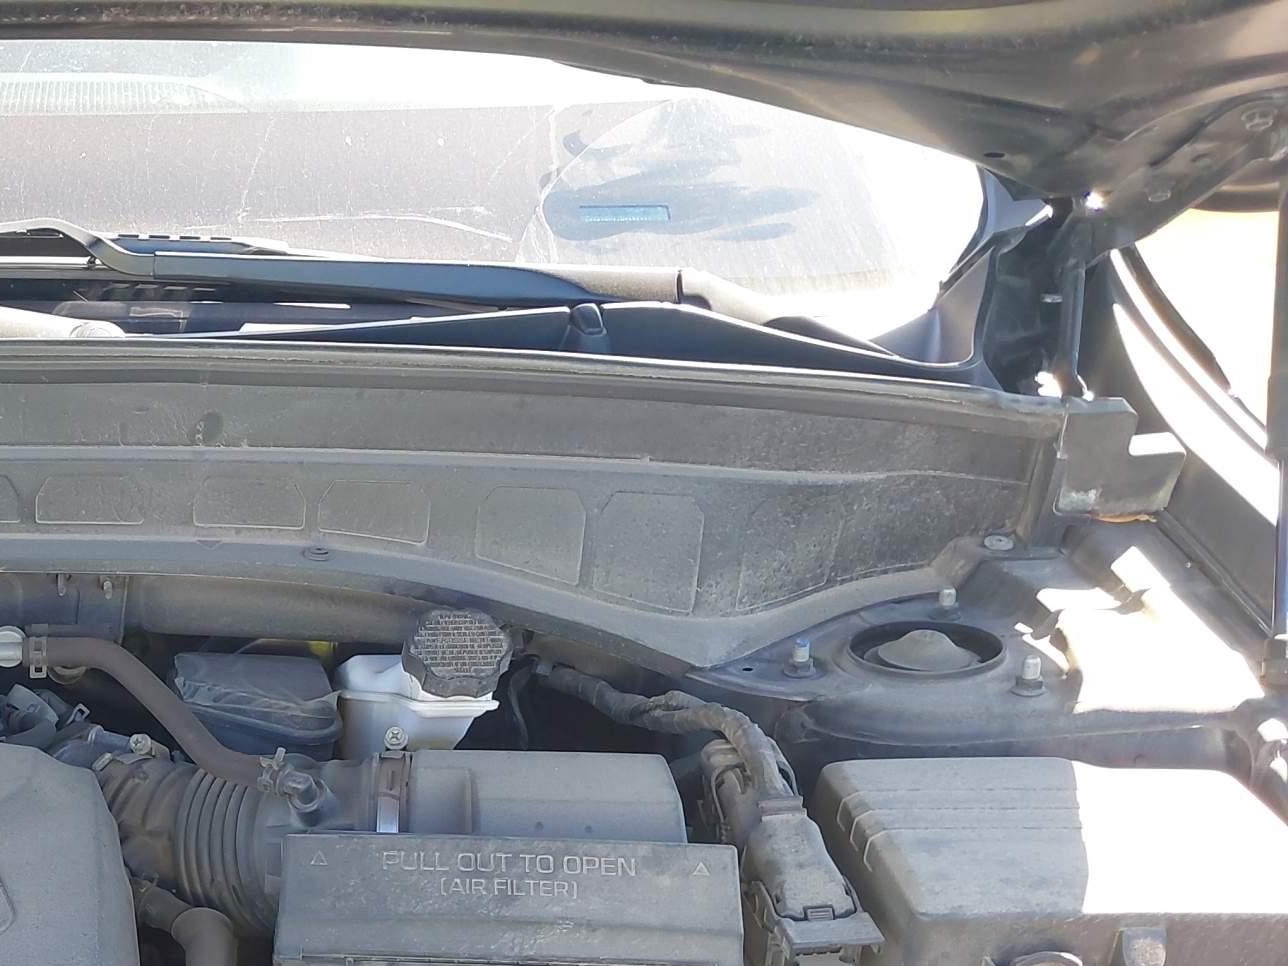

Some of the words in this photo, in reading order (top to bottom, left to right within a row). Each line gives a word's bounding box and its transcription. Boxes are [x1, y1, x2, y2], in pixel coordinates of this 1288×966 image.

[382, 851, 449, 871] PULL
[458, 853, 512, 872] OUT
[520, 854, 554, 874] TO
[563, 856, 636, 876] OPEN
